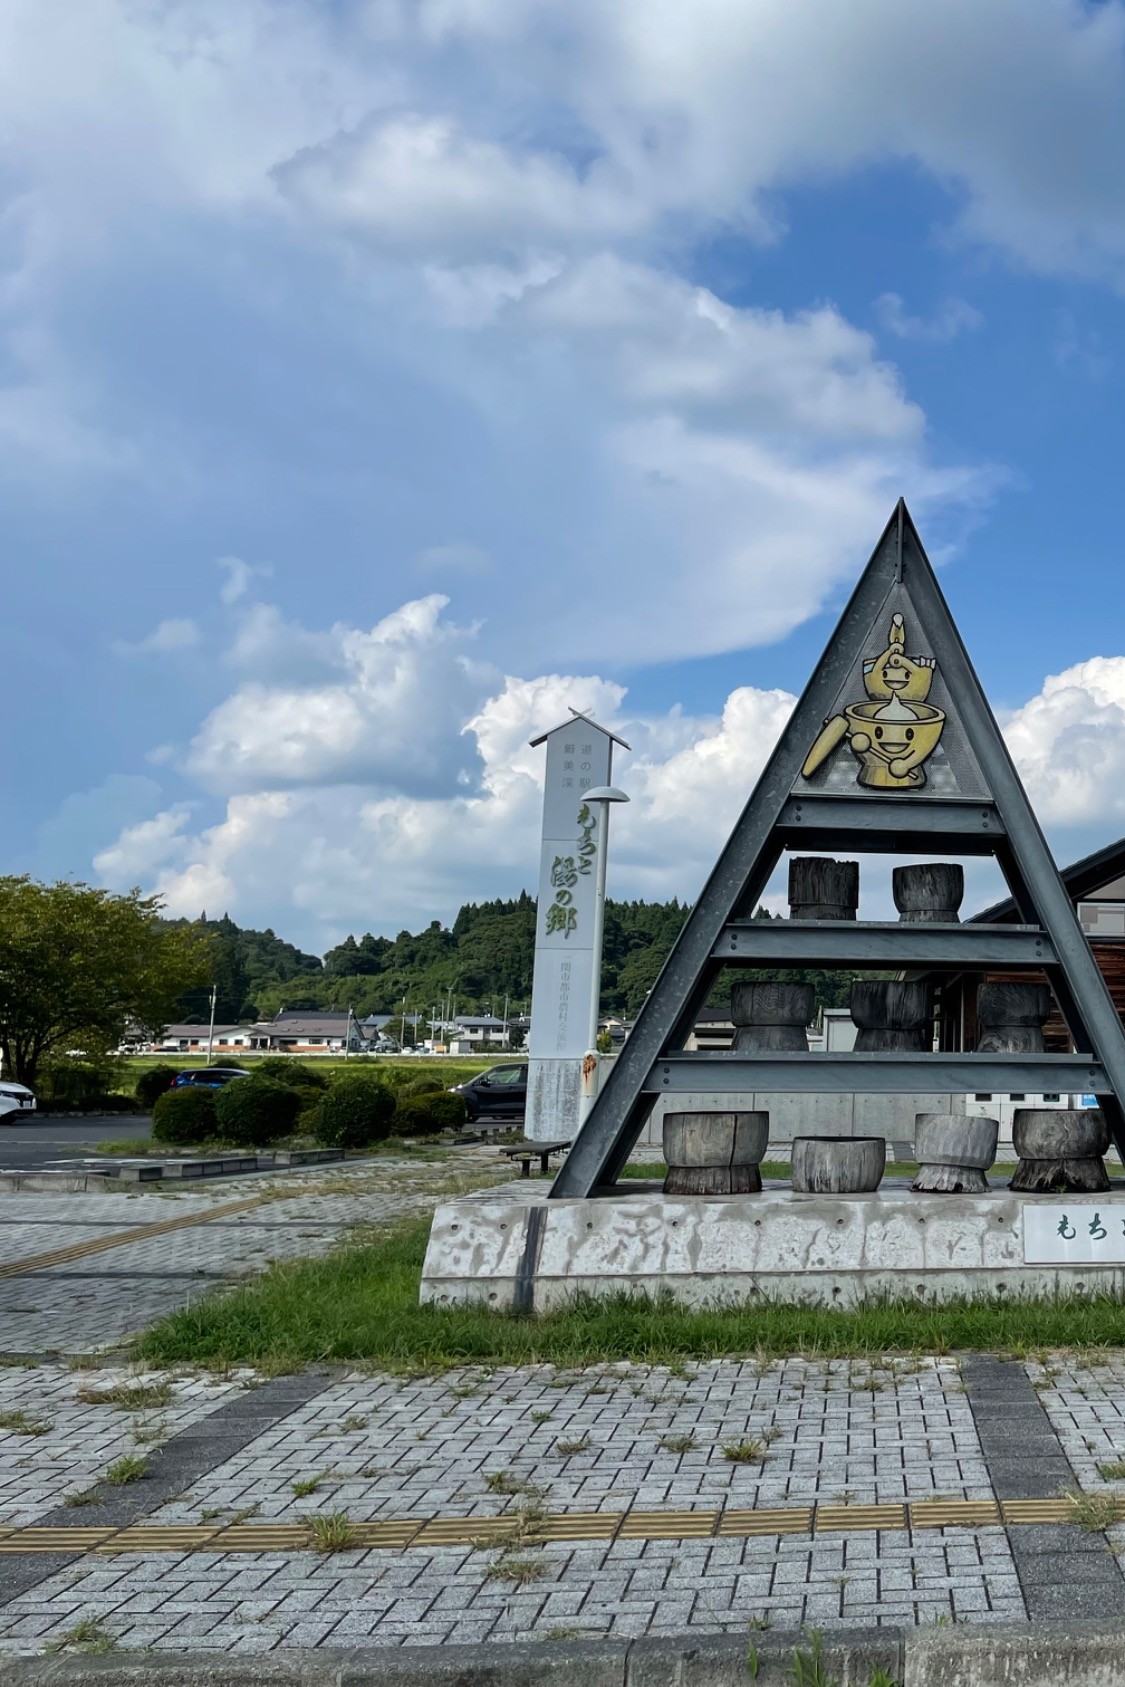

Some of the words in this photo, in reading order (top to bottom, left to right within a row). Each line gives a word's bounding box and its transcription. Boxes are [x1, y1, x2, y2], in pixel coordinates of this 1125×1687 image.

[577, 803, 596, 875] もちと
[545, 856, 578, 939] 湯の郷
